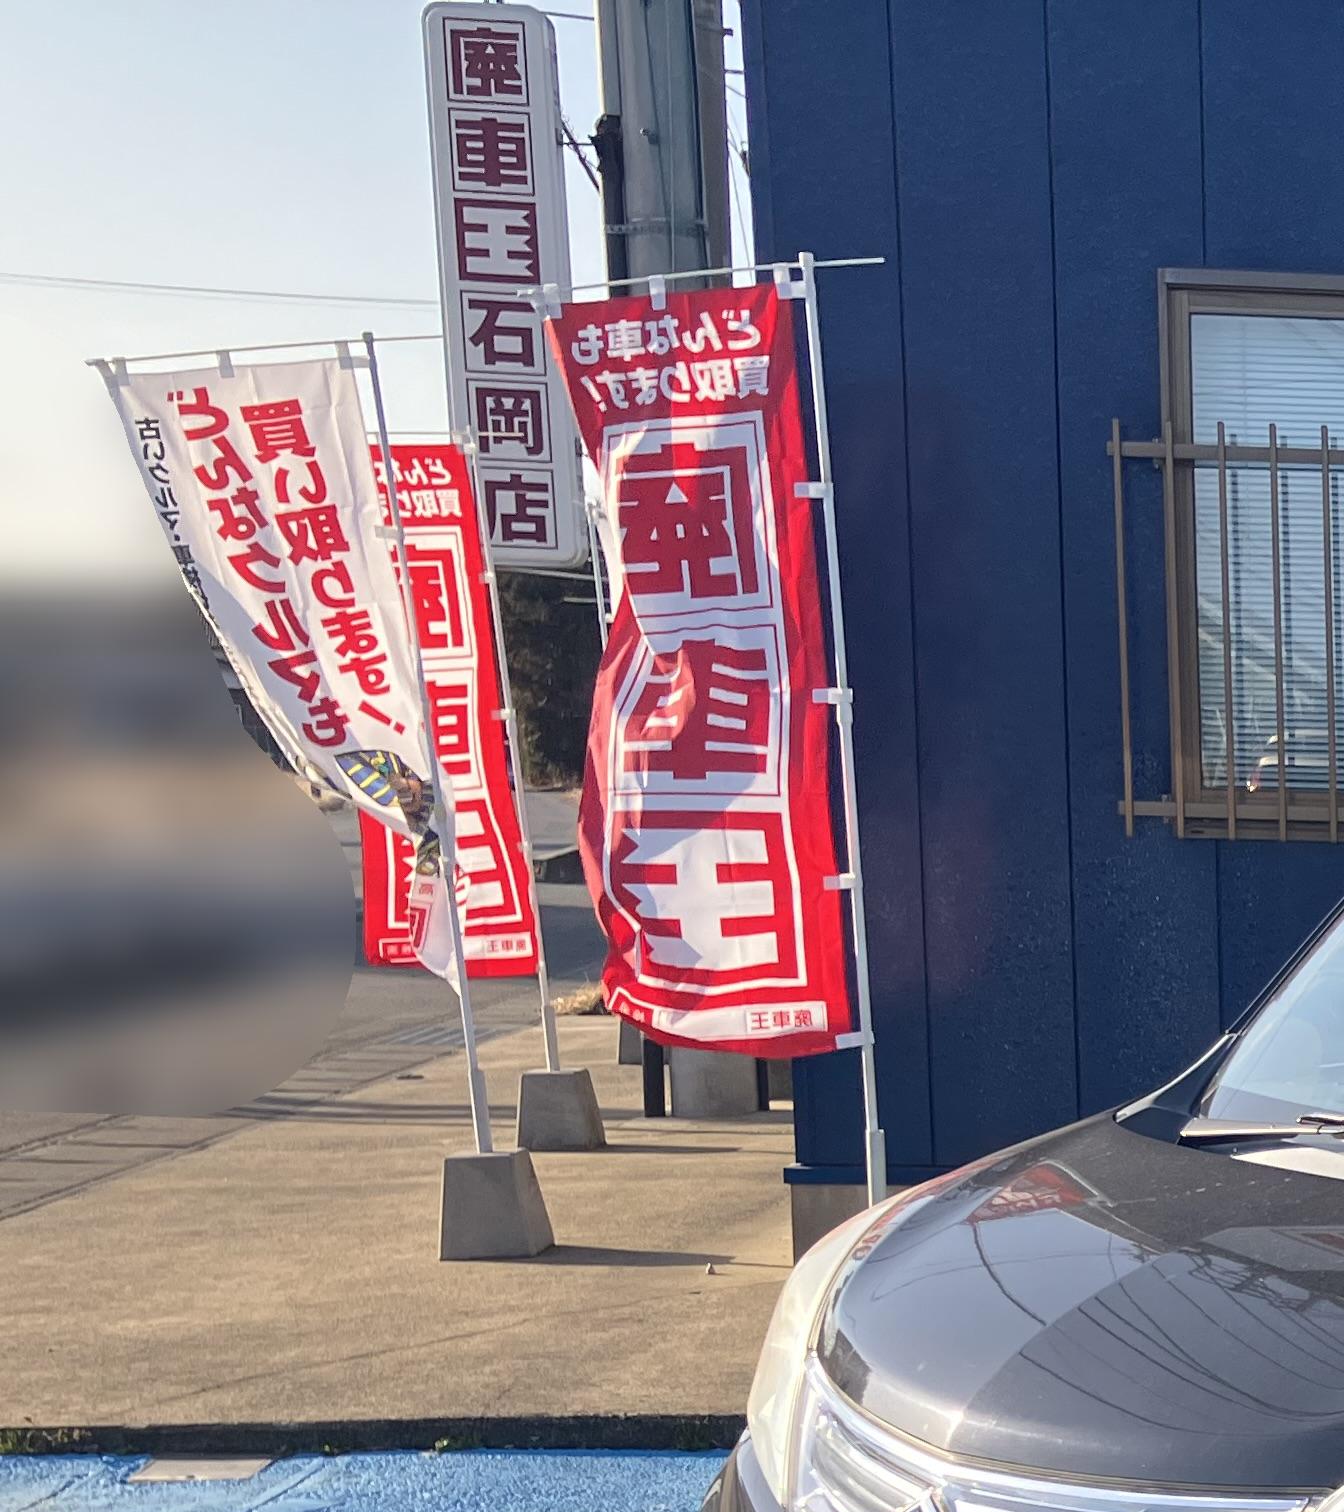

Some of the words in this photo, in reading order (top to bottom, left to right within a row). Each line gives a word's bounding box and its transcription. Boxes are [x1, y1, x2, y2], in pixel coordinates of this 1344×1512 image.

[449, 26, 548, 545] 廃車王石岡店
